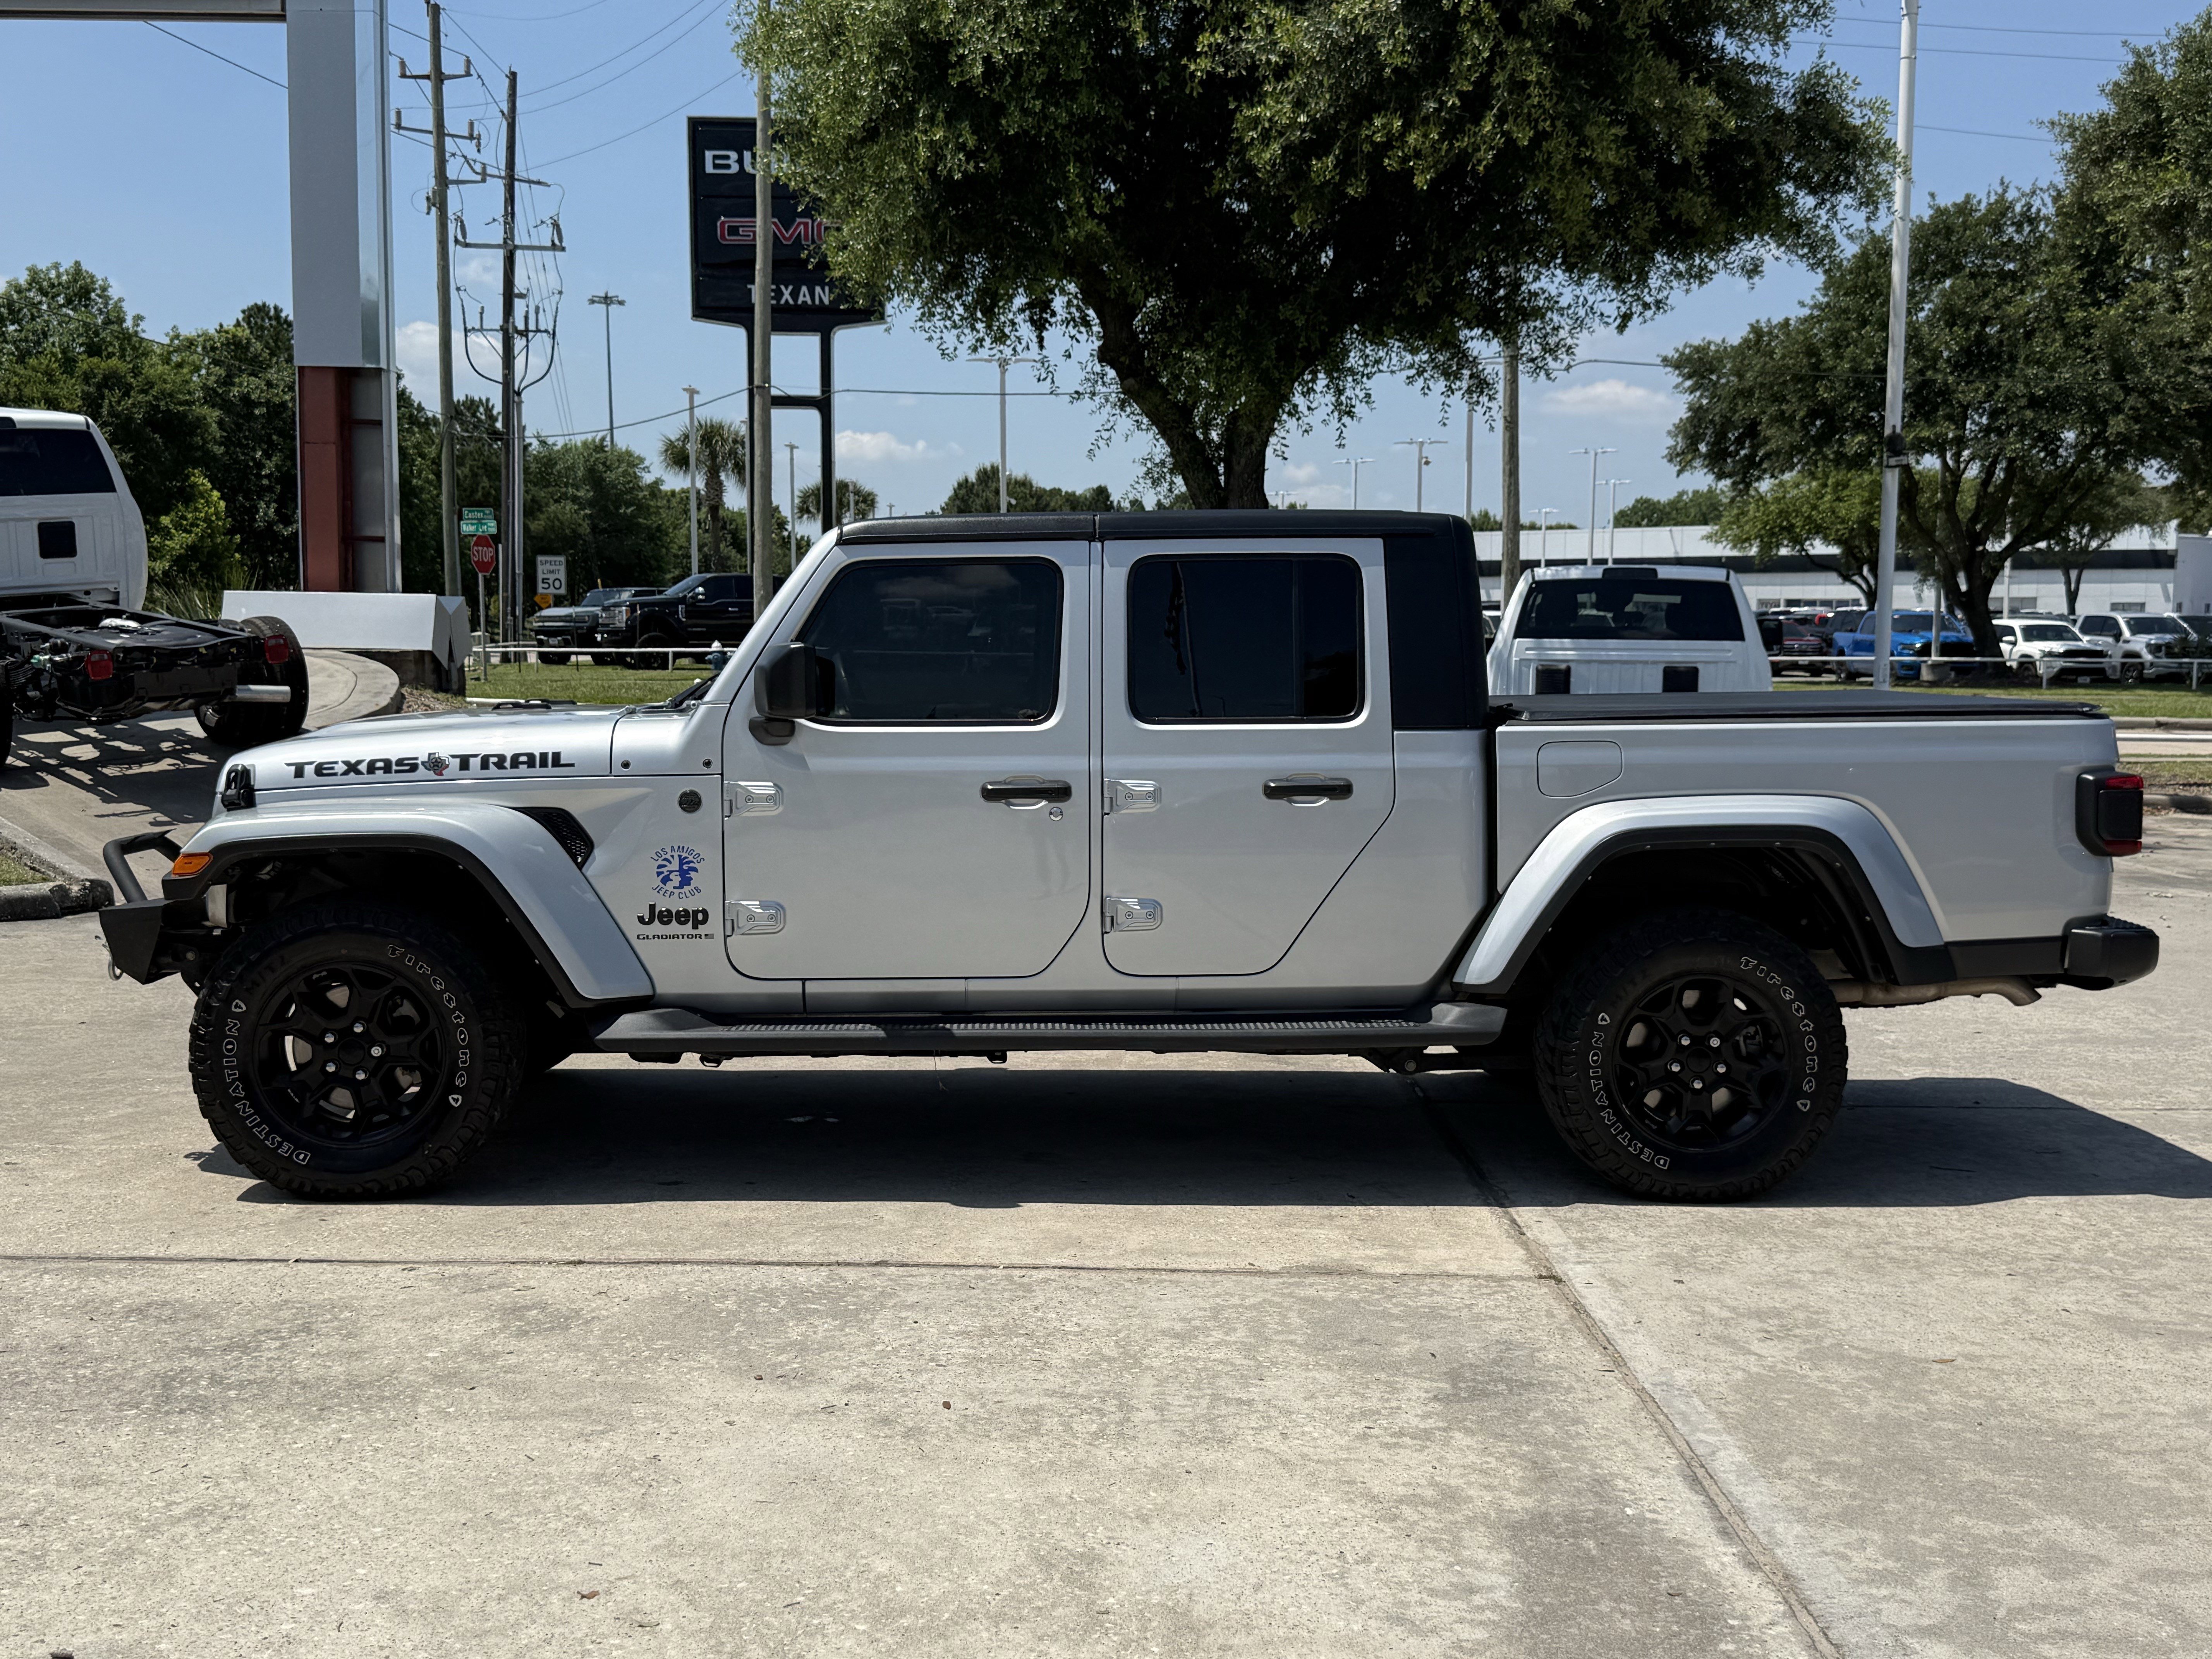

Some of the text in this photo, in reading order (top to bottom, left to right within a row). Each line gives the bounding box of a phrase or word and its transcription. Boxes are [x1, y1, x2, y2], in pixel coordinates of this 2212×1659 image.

[473, 546, 494, 563] STOP
[541, 578, 562, 590] 50
[283, 751, 576, 779] TEXAS TRAIL
[650, 845, 705, 864] LOS AMIGOS
[652, 884, 702, 900] JEEP CLUB
[637, 902, 709, 930] Jeep
[387, 943, 471, 1088] Firestone
[1740, 955, 1818, 1094] Firestone
[222, 1017, 312, 1165] DESTINATION
[1589, 1030, 1670, 1170] DESTINATION
